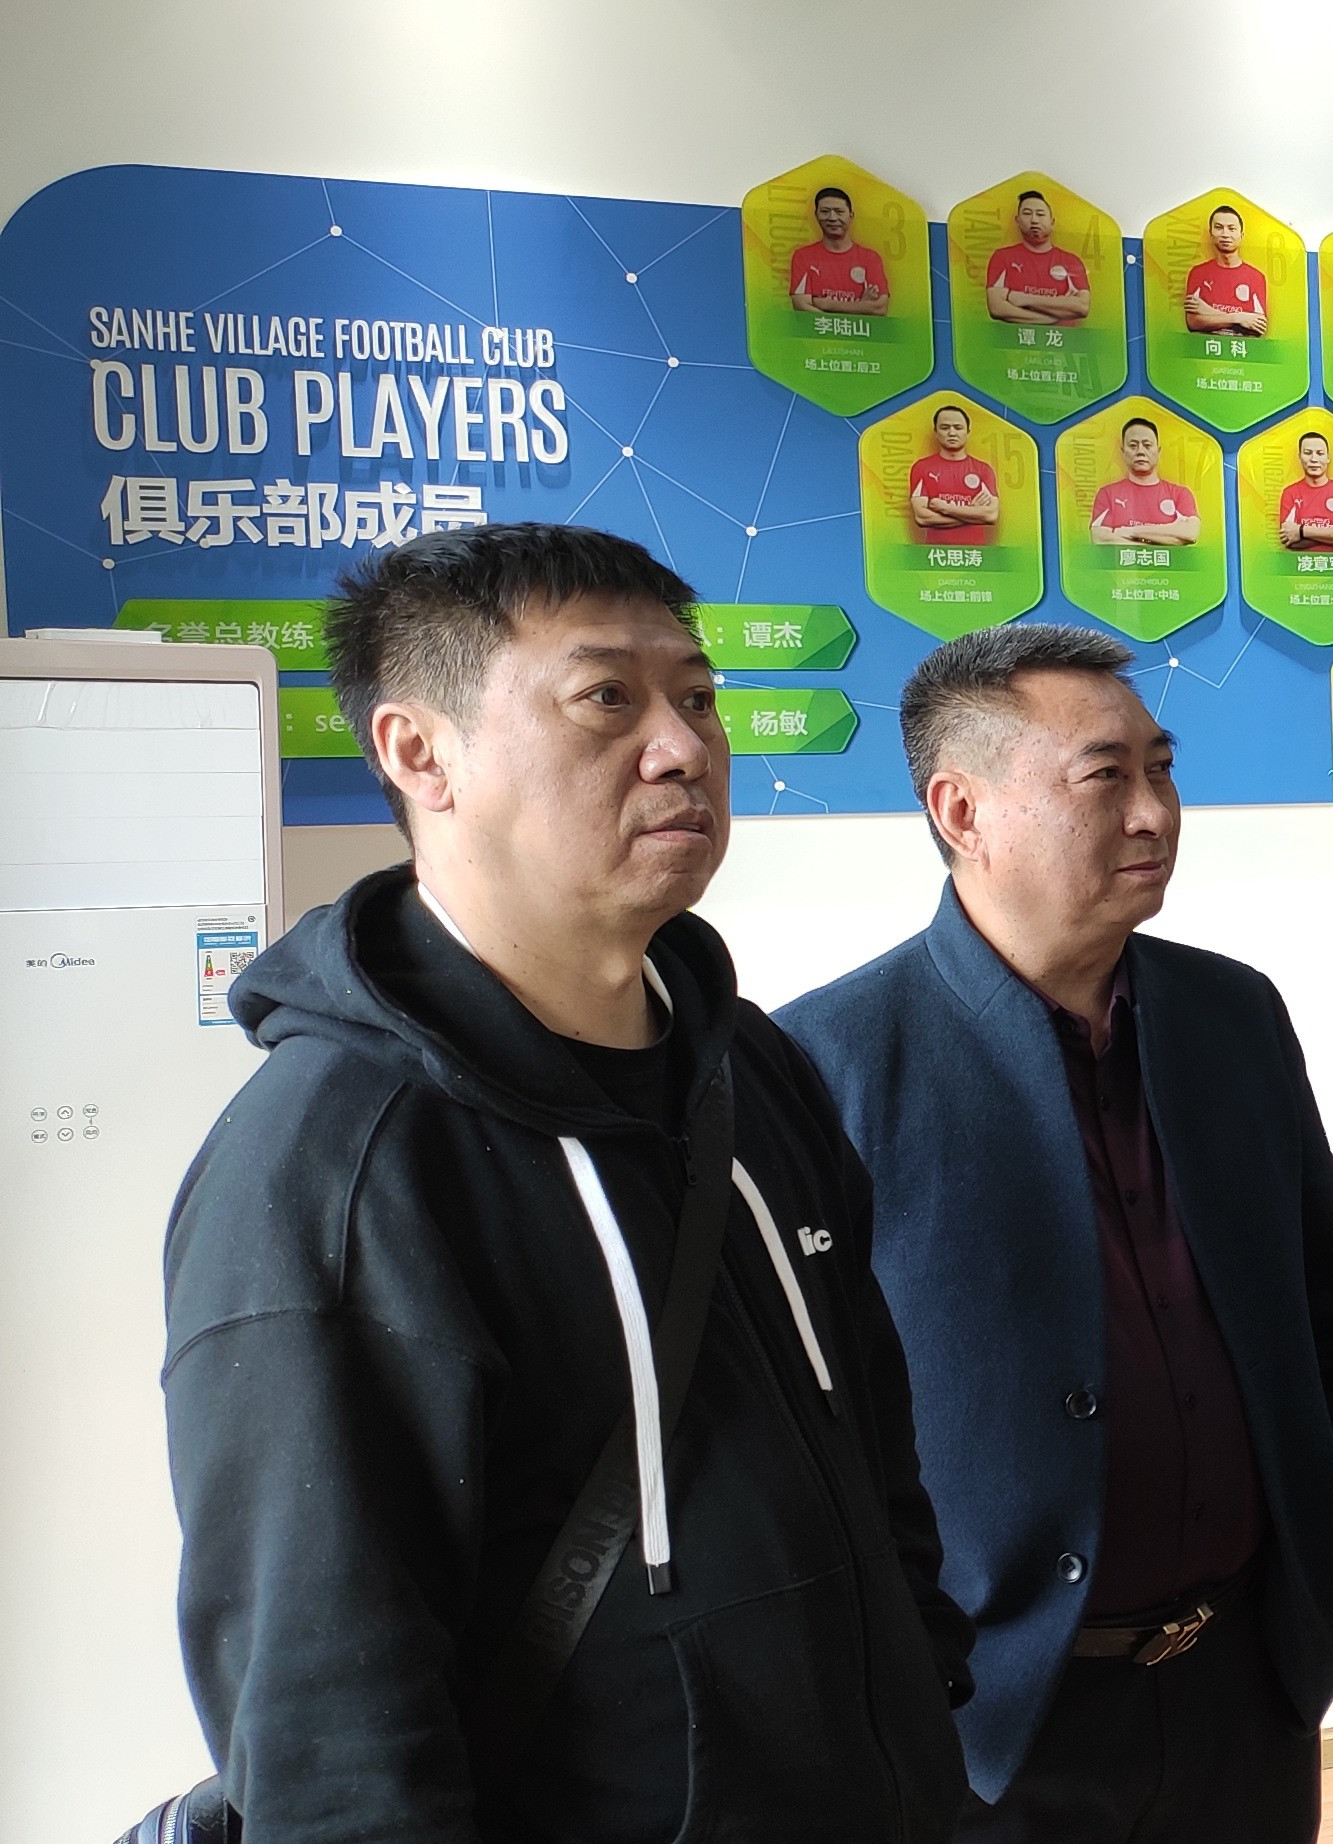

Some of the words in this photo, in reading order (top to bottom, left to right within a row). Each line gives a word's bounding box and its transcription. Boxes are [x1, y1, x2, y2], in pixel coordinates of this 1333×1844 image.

[814, 317, 870, 337] 李陆山
[90, 306, 194, 353] SANHE
[204, 312, 325, 360] VILLAGE
[336, 317, 474, 365] FOOTBALL
[482, 327, 555, 369] CLUB
[1018, 328, 1063, 347] 谭龙
[1205, 339, 1248, 358] 向科
[805, 359, 881, 374] 场上位置:后卫
[1008, 368, 1078, 383] 场上位置:后卫
[1197, 377, 1263, 392] 场上位置:后卫
[91, 361, 268, 455] CLUB
[295, 369, 568, 465] PLAYERS
[100, 475, 488, 550] 俱乐部成员
[928, 549, 983, 567] 代思涛
[1119, 549, 1170, 567] 廖志国
[920, 590, 993, 603] 场上位置:前锋
[1112, 589, 1180, 601] 场上位置:中场
[59, 957, 96, 967] Midea
